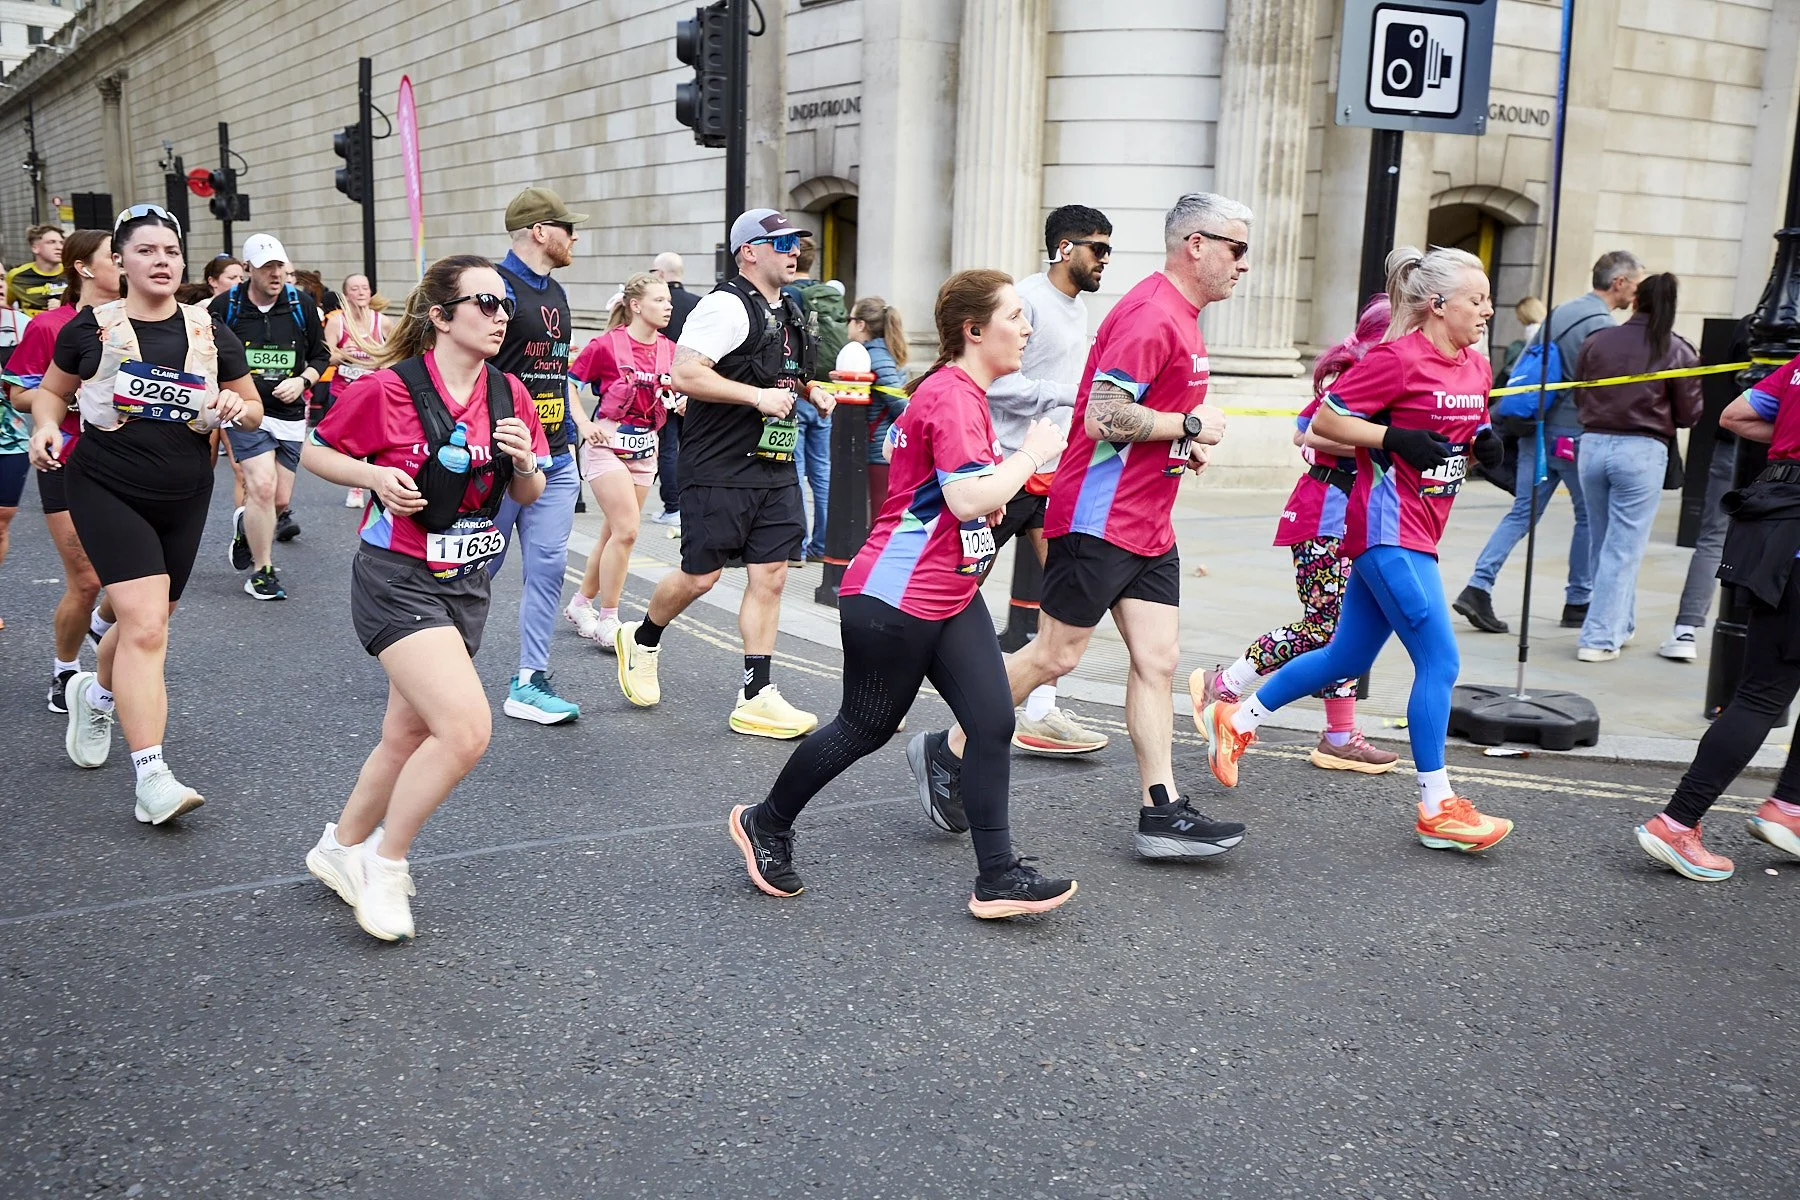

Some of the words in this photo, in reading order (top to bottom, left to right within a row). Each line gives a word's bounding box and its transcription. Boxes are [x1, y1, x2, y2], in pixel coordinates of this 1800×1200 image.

[253, 352, 289, 365] 5846
[150, 368, 180, 379] CLAIRE
[533, 359, 562, 374] Charity
[776, 376, 796, 391] arity
[128, 378, 192, 405] 9265
[405, 460, 419, 469] The
[435, 532, 501, 559] 11635
